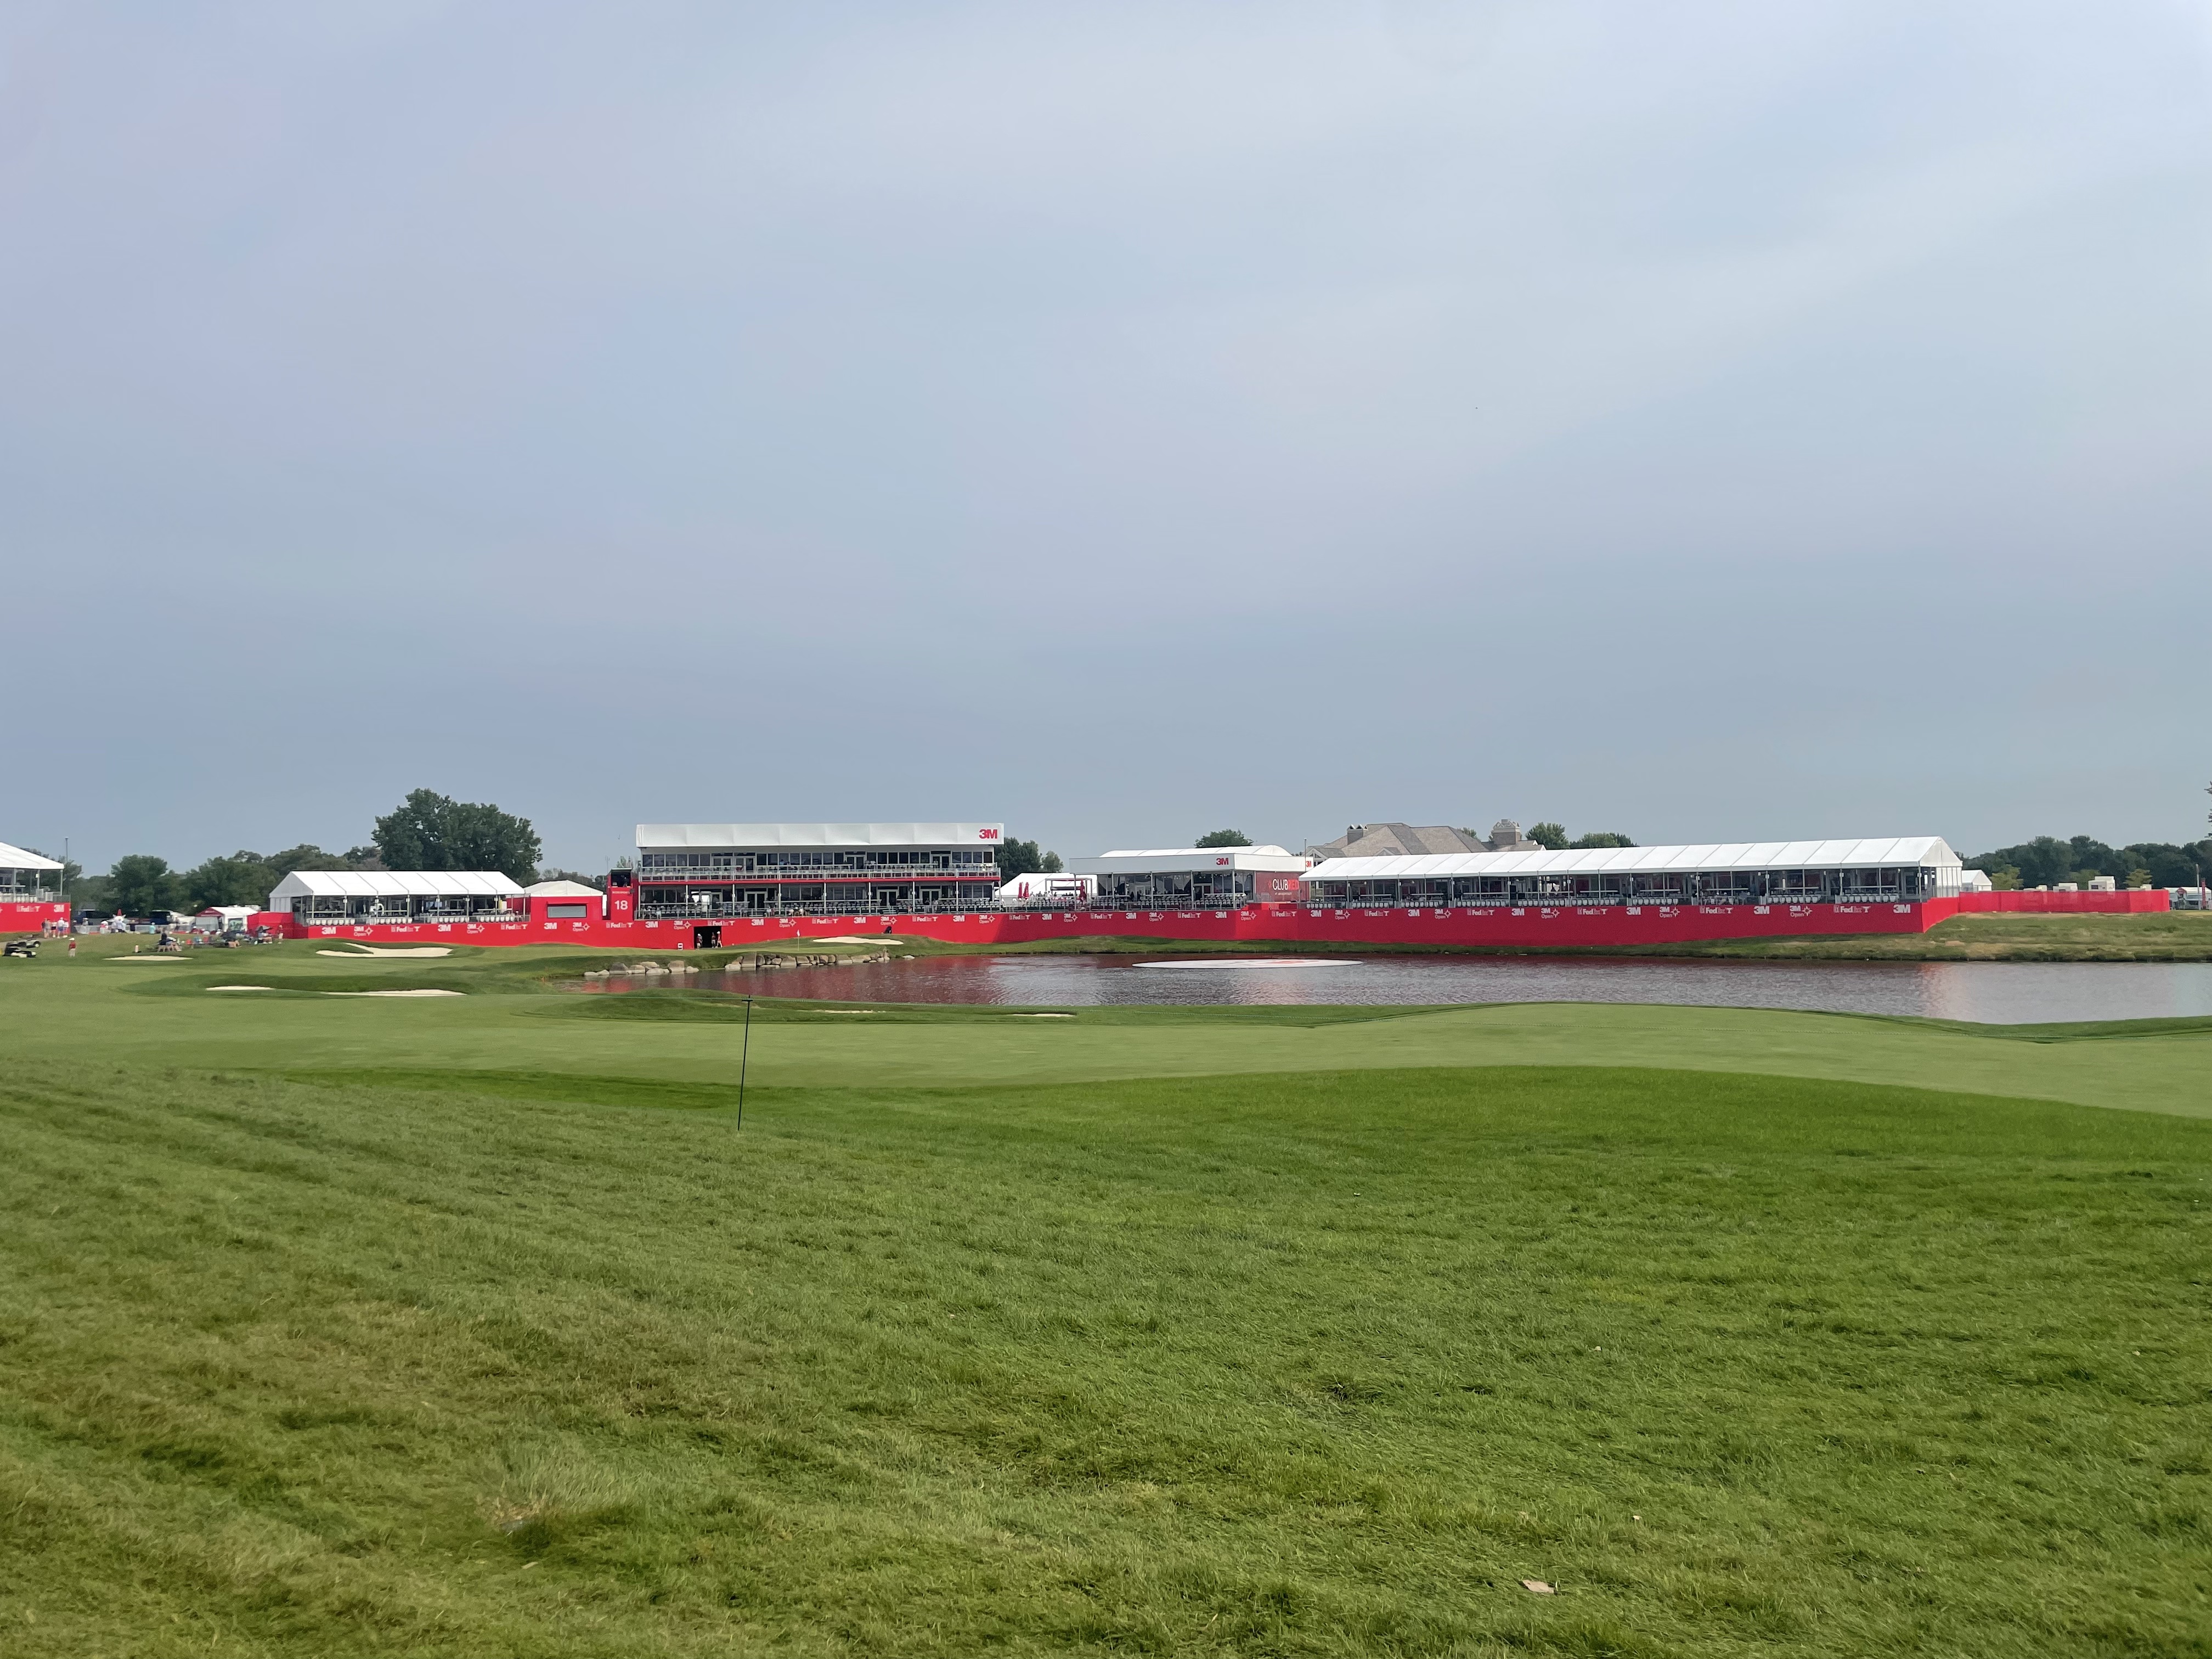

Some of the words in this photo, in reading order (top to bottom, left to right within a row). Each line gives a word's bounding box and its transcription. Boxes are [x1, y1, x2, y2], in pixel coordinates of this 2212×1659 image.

[979, 829, 997, 839] 3M
[615, 900, 628, 910] 18
[1893, 904, 1910, 913] 3M
[1627, 907, 1641, 915] 3M
[1754, 906, 1769, 914] 3M
